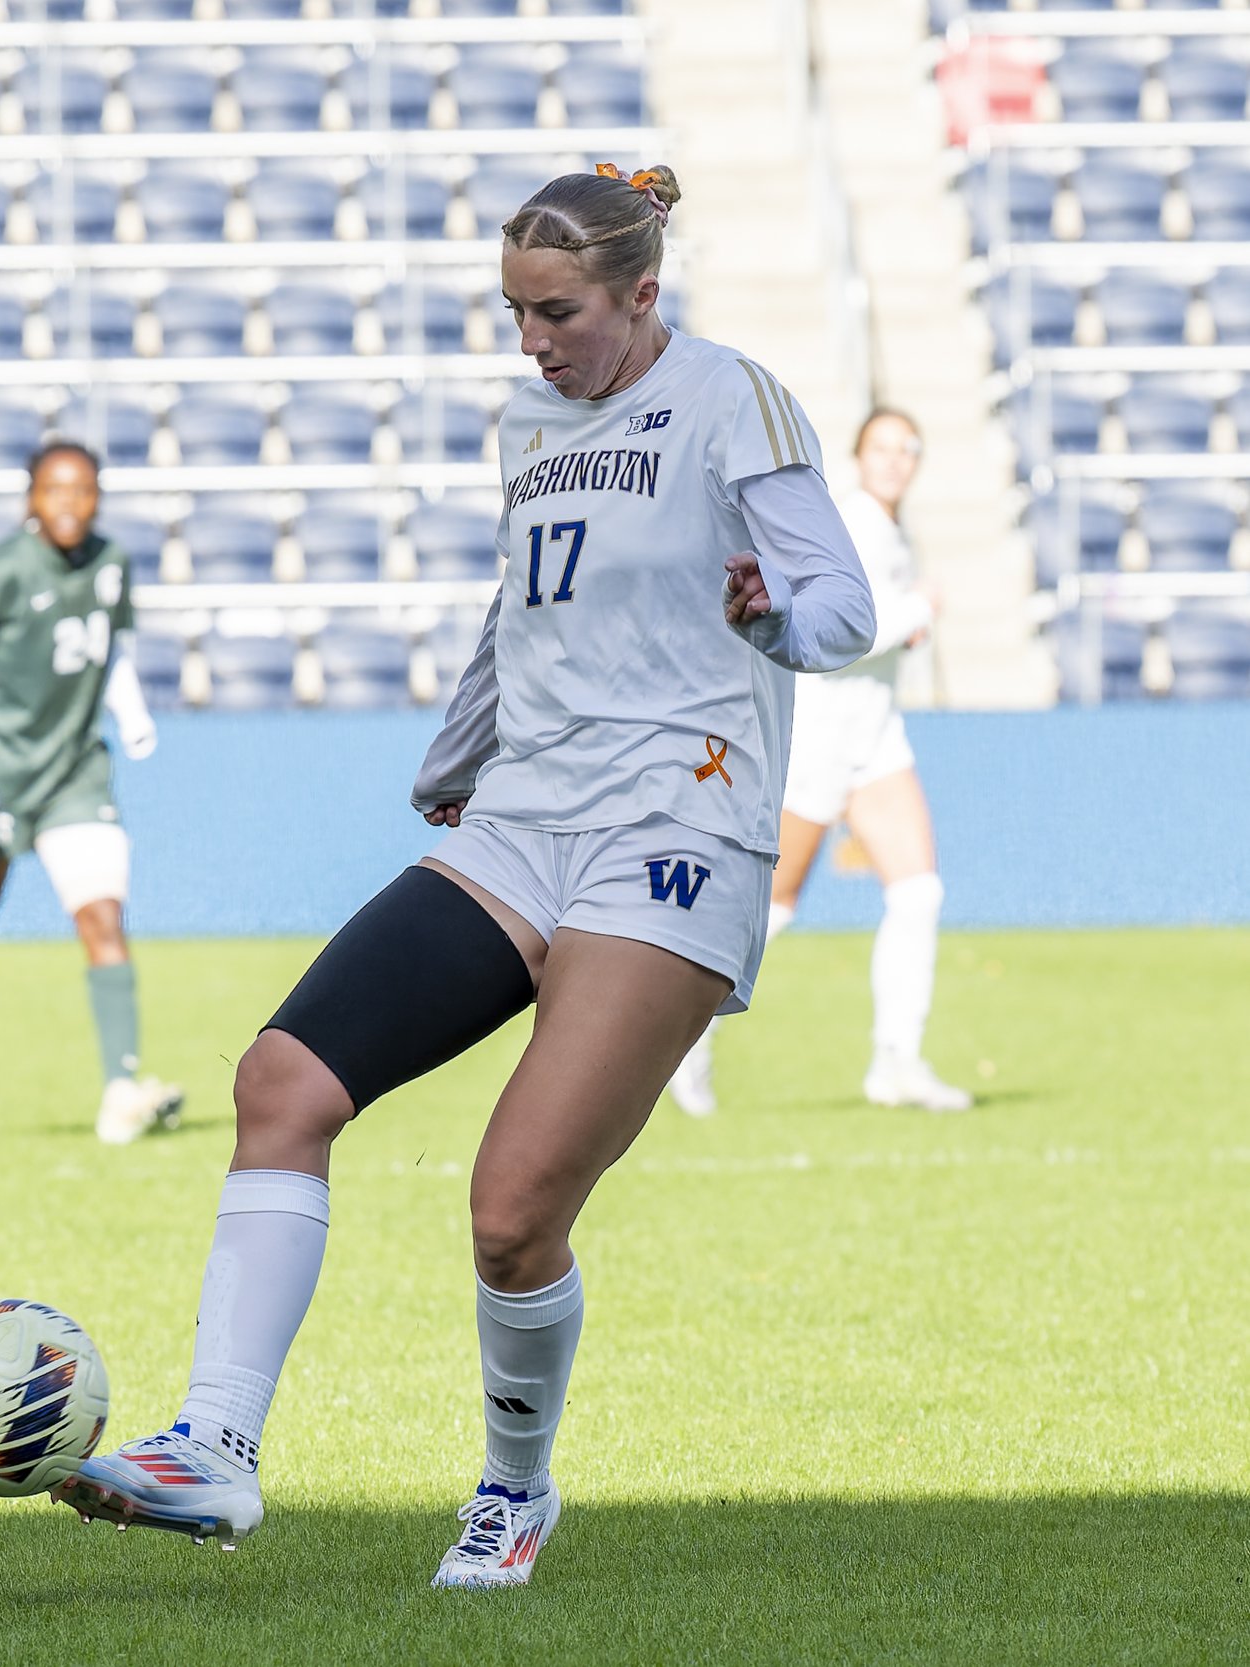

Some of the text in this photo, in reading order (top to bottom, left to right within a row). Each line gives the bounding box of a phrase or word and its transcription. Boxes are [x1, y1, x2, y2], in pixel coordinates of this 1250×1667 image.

[507, 448, 661, 514] WASHINGTON
[526, 517, 588, 609] 17
[644, 858, 711, 911] W
